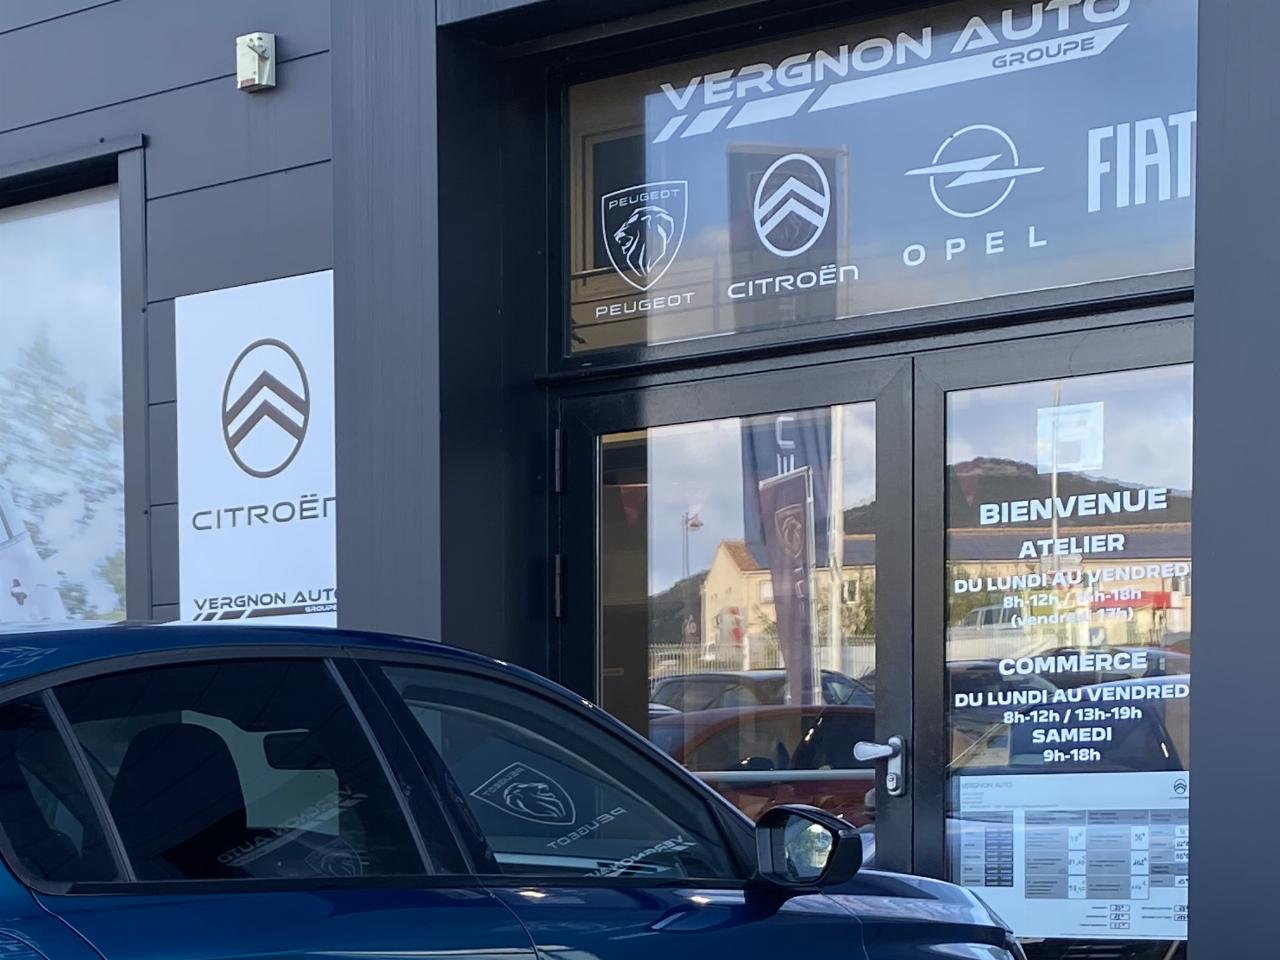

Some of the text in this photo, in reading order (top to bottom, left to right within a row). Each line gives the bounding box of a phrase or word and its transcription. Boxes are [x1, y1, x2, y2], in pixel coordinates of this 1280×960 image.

[660, 0, 1131, 110] VERGNON AUTO
[991, 36, 1096, 69] GROUPE
[1087, 110, 1197, 213] FIAT
[608, 188, 681, 211] PEUGEOT
[902, 226, 1048, 267] OPEL
[595, 291, 696, 319] PEUGEOT
[980, 488, 1168, 525] BIENVENUE
[1019, 533, 1125, 559] ATELIER
[954, 578, 982, 594] DU
[987, 573, 1047, 592] LUNDI
[1052, 568, 1082, 586] AU
[194, 588, 337, 611] VERGNON AUT
[999, 652, 1147, 676] COMMERCE
[954, 693, 982, 707] DU
[987, 689, 1047, 706] LUNDI
[1052, 687, 1082, 703] AU
[1003, 706, 1142, 724] 8h-12h / 13h-19h
[1032, 727, 1112, 743] SAMEDI
[1043, 749, 1101, 762] 9h-18h
